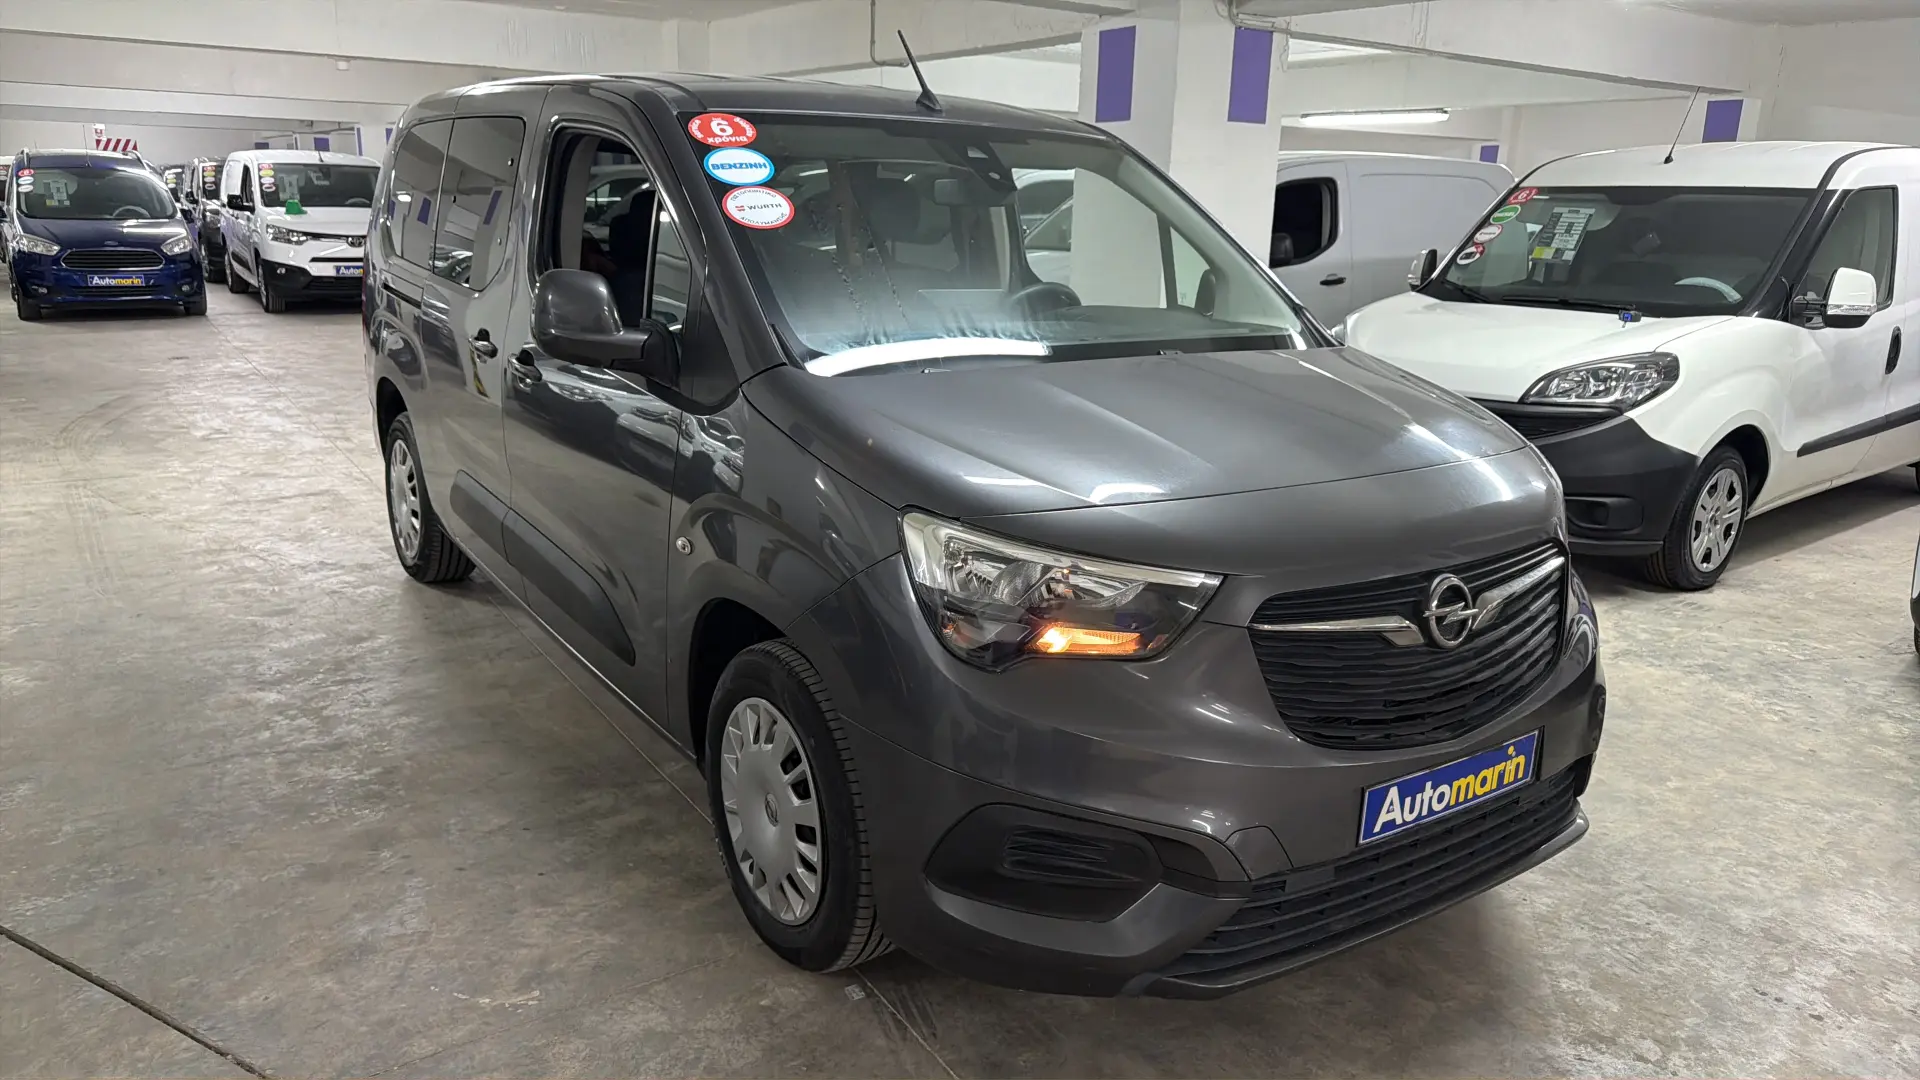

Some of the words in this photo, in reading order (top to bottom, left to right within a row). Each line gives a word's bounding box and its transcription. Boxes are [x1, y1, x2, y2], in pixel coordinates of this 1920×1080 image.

[710, 120, 734, 136] 6
[707, 136, 748, 145] χρόνια
[92, 275, 142, 286] Automarin
[1372, 745, 1526, 833] Automarin
